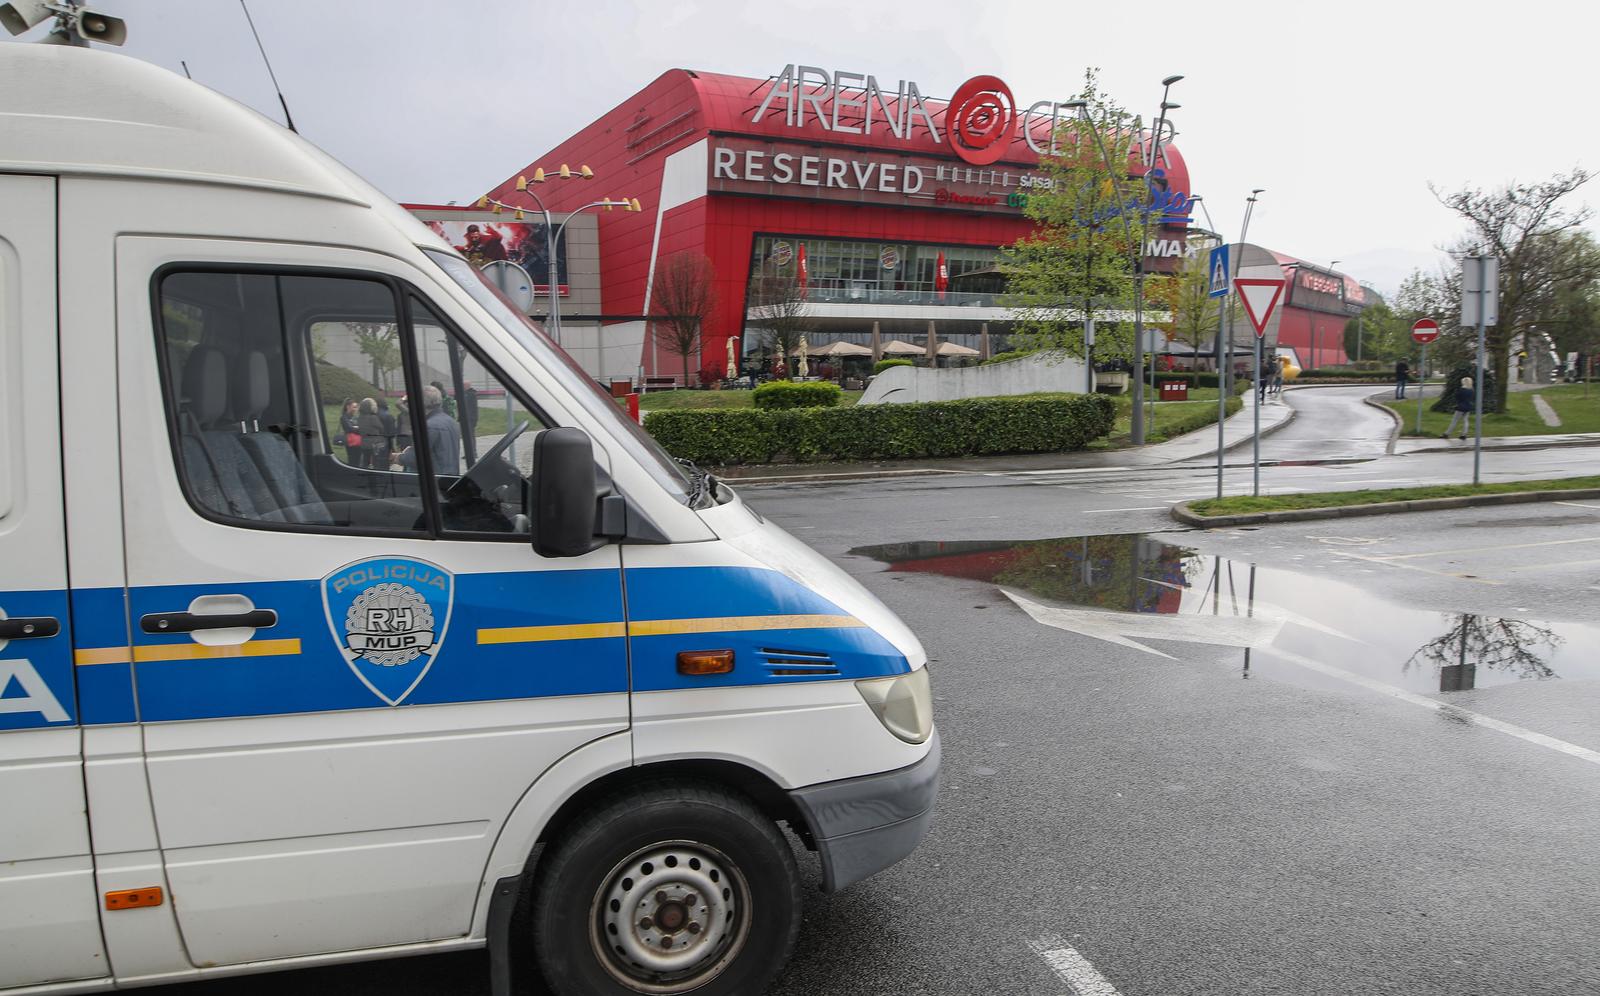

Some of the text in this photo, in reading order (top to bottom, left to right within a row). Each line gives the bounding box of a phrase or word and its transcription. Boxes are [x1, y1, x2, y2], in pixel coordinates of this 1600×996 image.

[751, 63, 942, 144] ARENA
[713, 147, 924, 194] RESERVED
[935, 165, 1009, 187] MOHITO
[1139, 239, 1198, 259] IMAX
[333, 564, 446, 594] POLICIJA
[366, 607, 415, 633] RH
[365, 636, 417, 649] MUP
